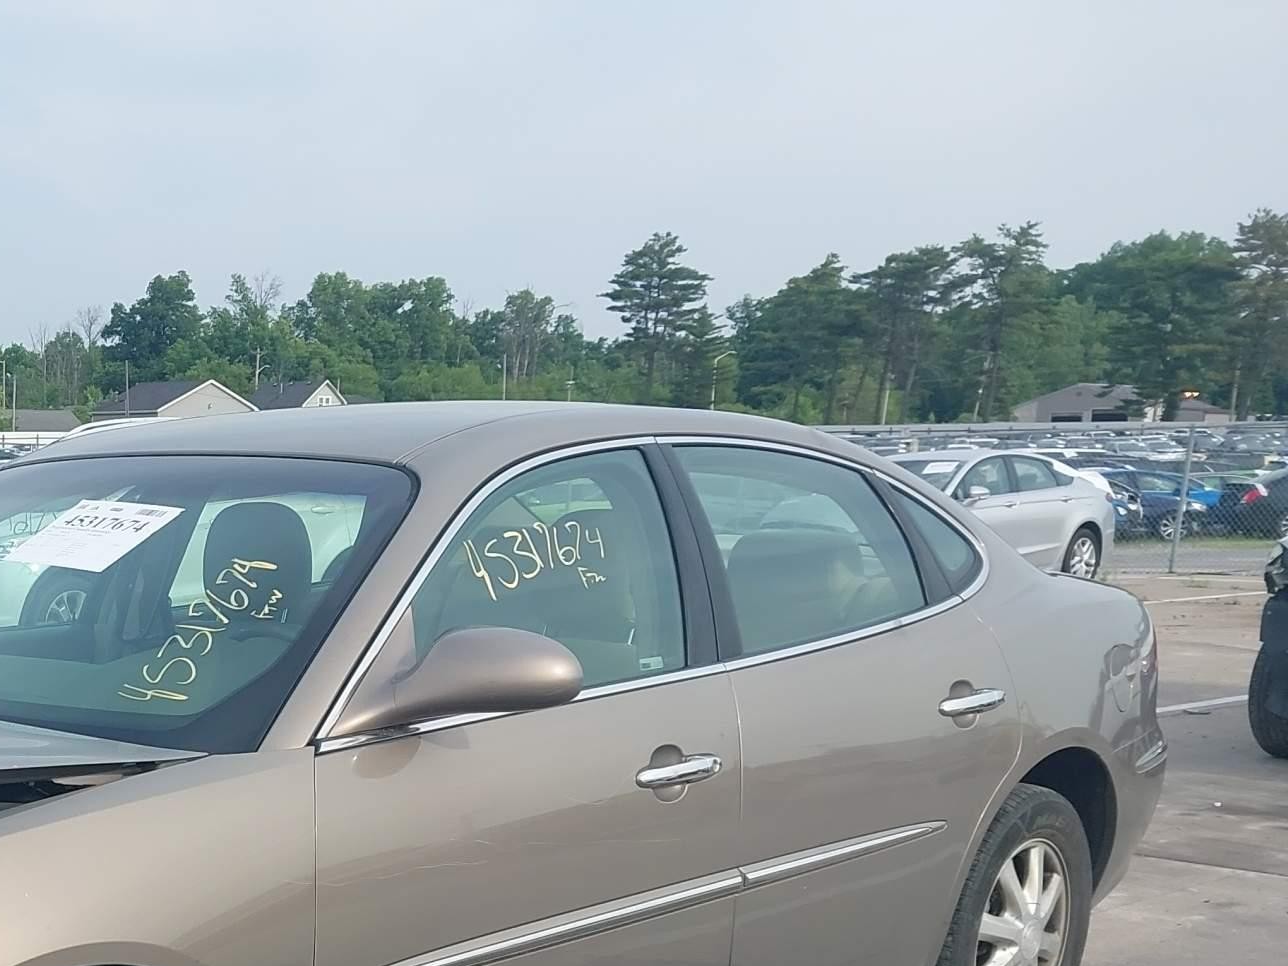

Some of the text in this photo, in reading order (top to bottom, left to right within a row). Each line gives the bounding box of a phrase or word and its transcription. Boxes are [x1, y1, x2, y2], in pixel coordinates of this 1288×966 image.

[64, 514, 150, 533] 45317674
[463, 521, 605, 600] 45317674
[118, 558, 278, 700] 45317674
